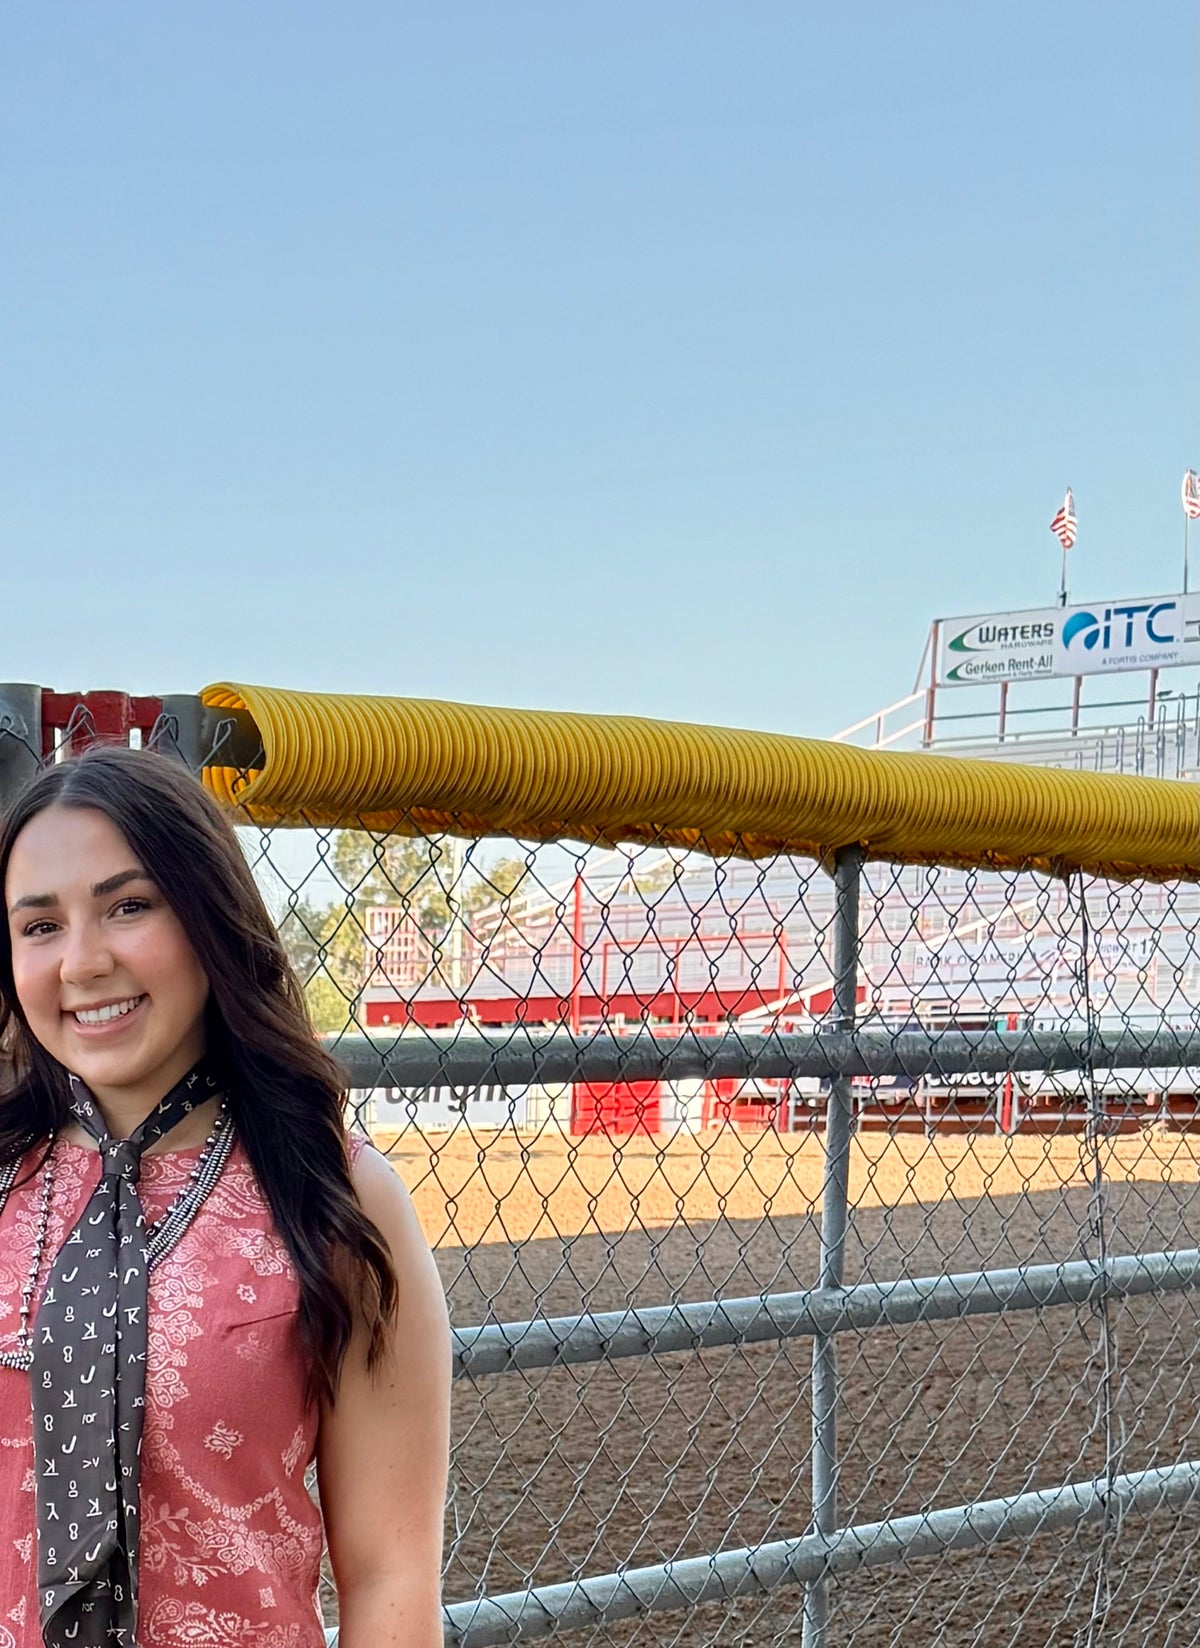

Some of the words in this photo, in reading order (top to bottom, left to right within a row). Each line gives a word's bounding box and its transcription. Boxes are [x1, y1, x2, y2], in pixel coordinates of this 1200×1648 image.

[1103, 602, 1176, 649] ITC
[978, 623, 1054, 644] WATERS
[1000, 639, 1053, 650] HARDWARE
[1108, 655, 1137, 665] FORTIS
[1139, 652, 1179, 662] COMPANY
[965, 660, 1005, 675] Gerken
[981, 952, 1037, 965] AMERIA
